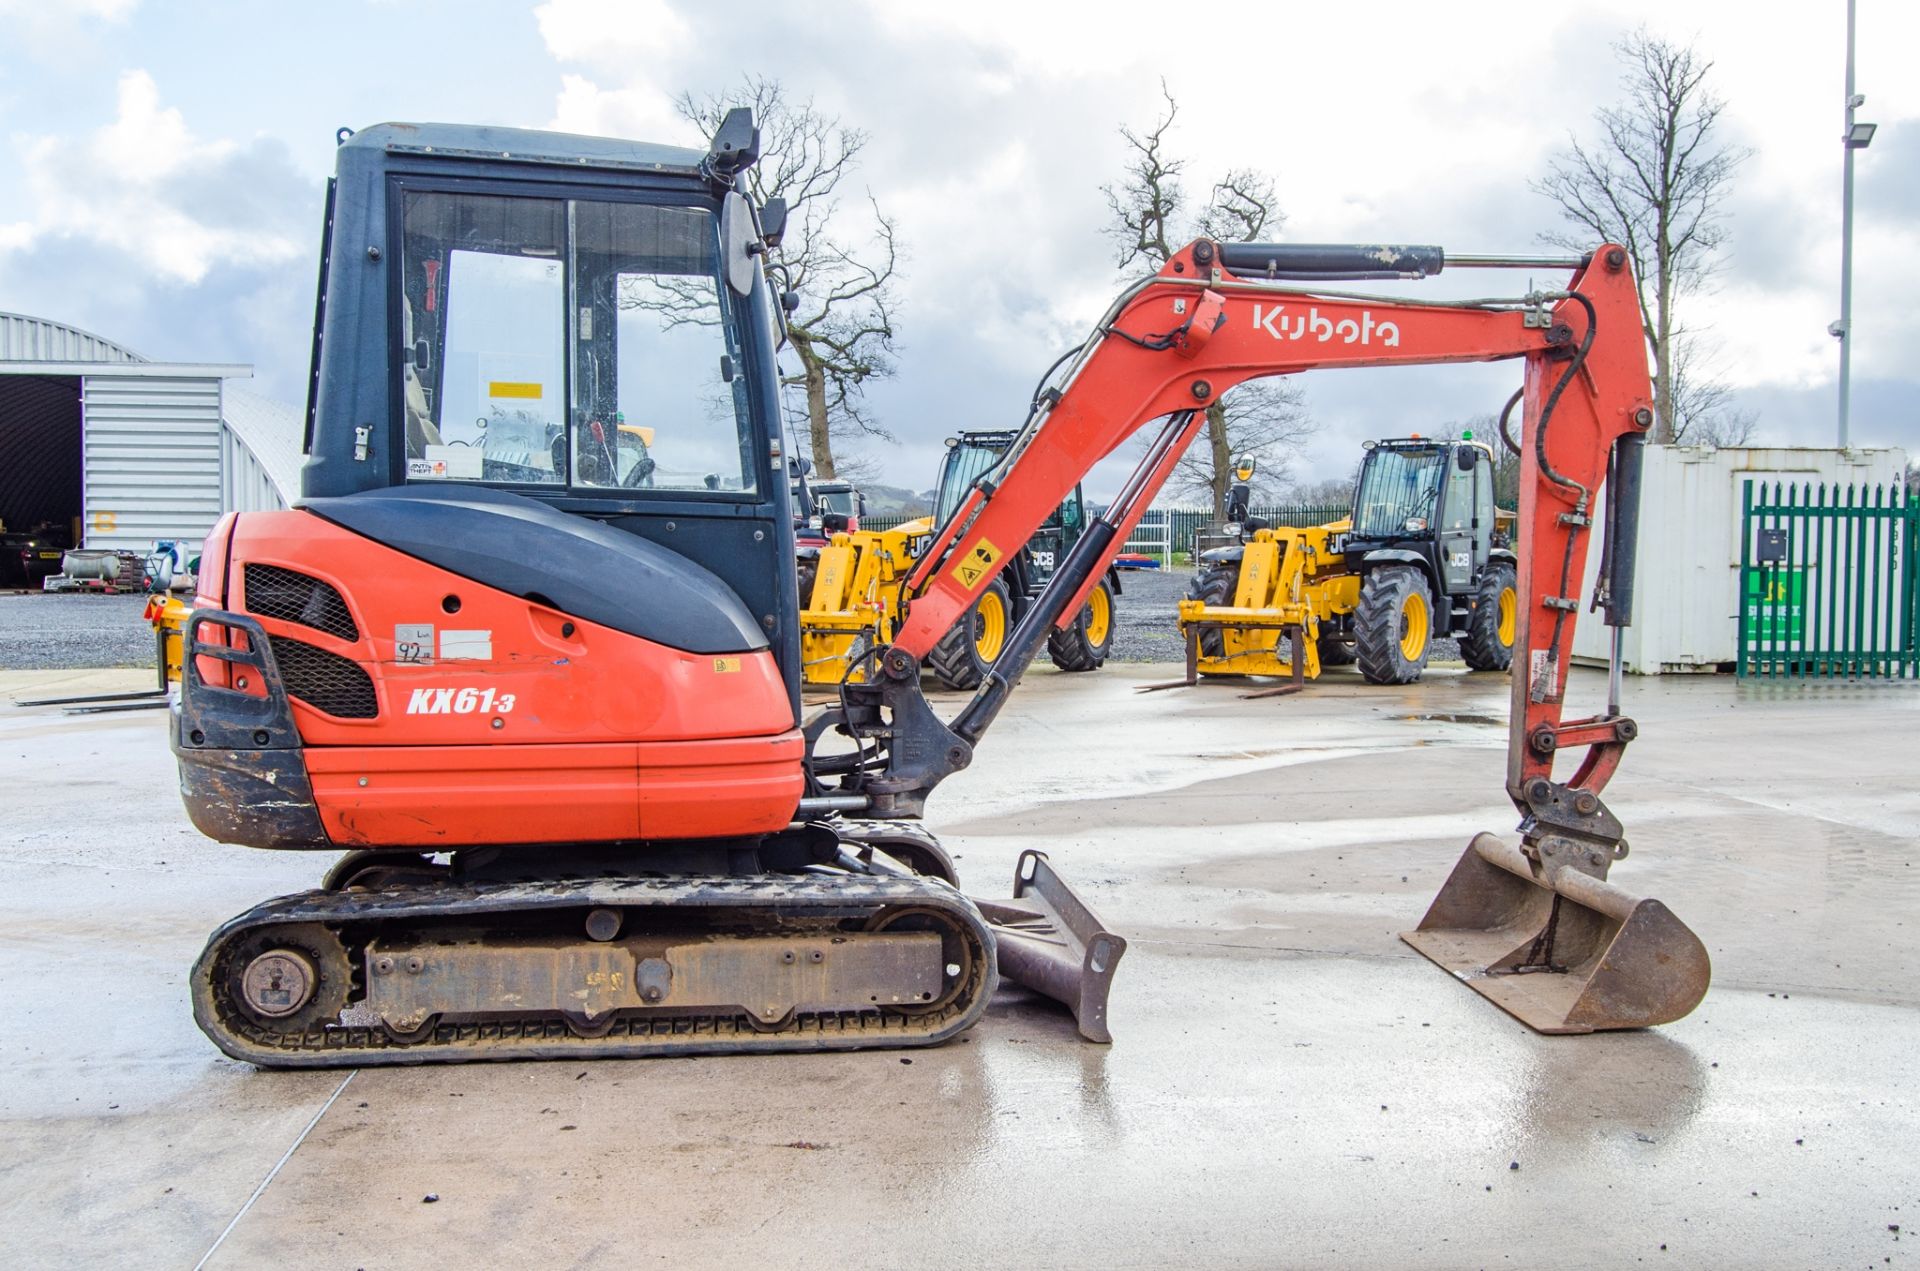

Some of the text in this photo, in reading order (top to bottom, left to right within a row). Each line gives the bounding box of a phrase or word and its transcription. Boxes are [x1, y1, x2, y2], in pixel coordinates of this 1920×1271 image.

[1253, 304, 1400, 347] Kubota
[910, 535, 933, 558] JC
[1330, 534, 1348, 554] JC
[1033, 551, 1054, 566] JCB
[1451, 552, 1469, 567] JCB
[406, 687, 516, 715] KX61-3
